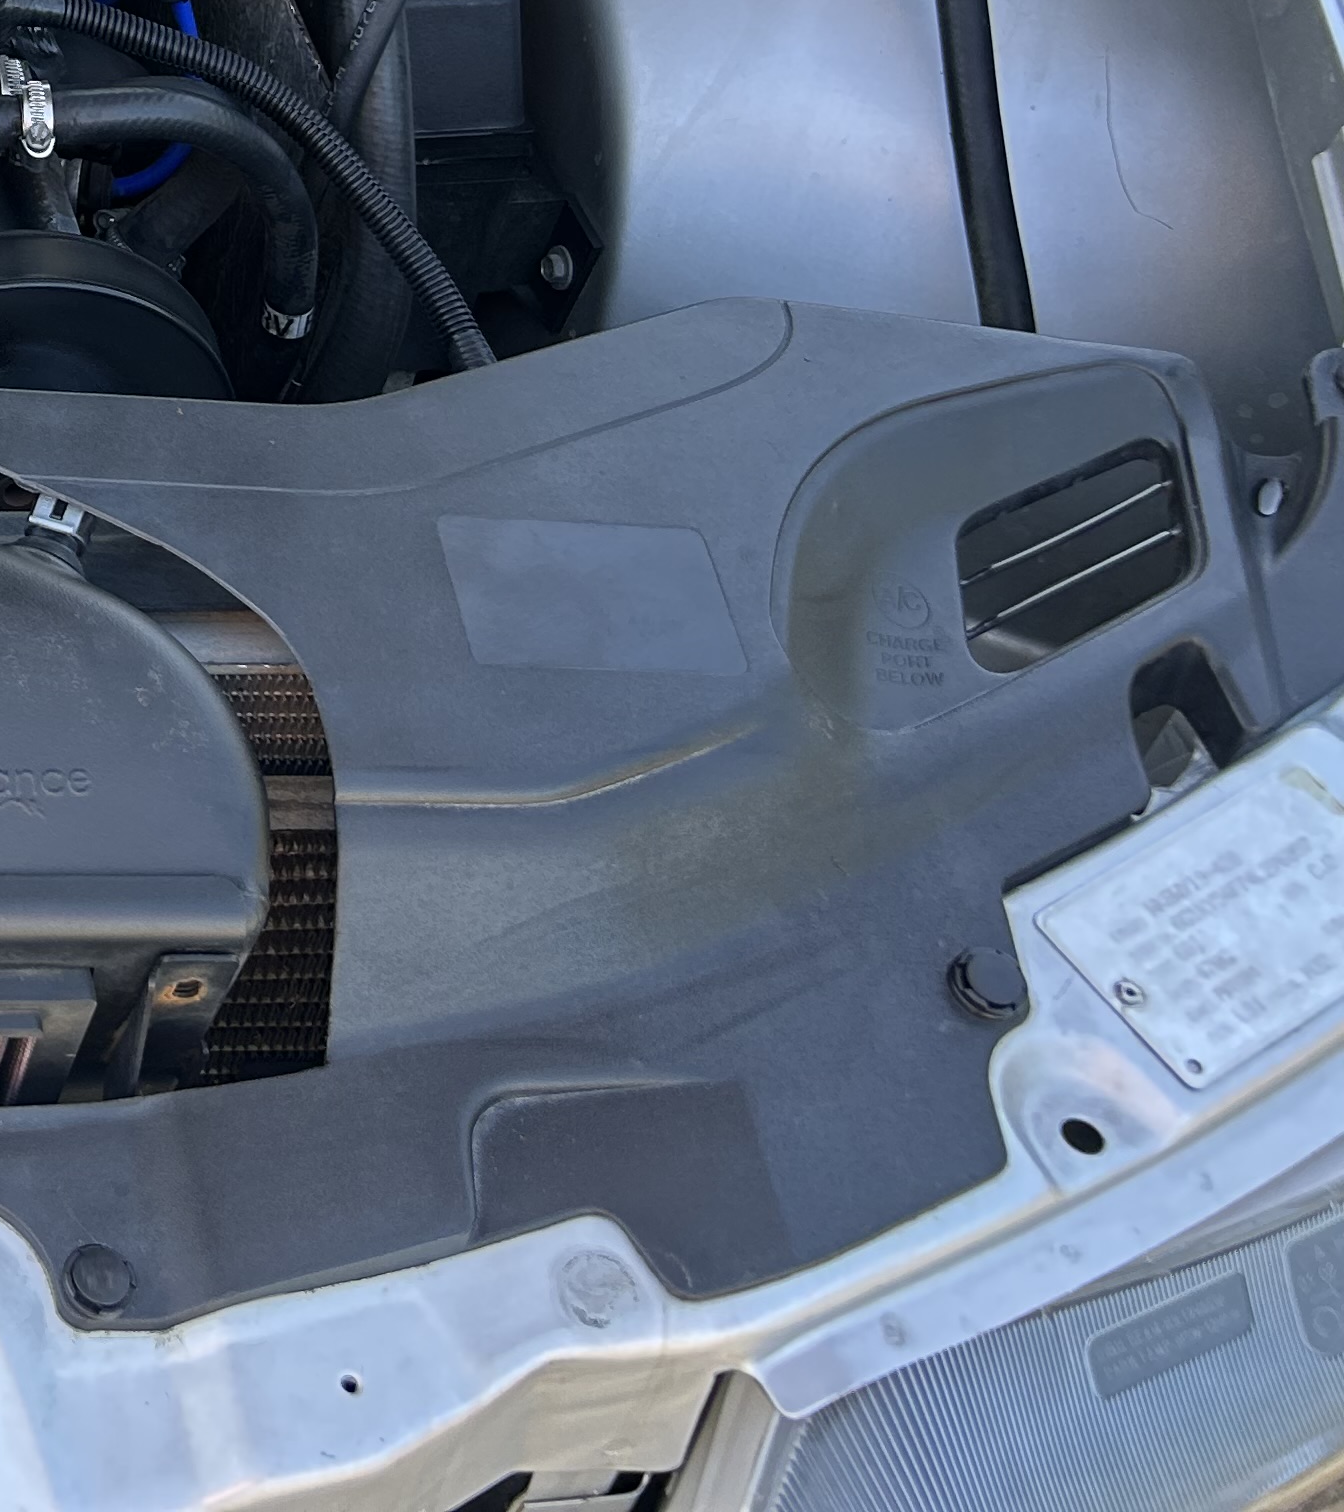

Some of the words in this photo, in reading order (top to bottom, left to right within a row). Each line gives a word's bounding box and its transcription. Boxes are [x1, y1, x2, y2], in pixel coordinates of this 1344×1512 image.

[866, 629, 947, 653] CHARGE
[881, 651, 931, 668] PORT
[875, 668, 945, 687] BELOW
